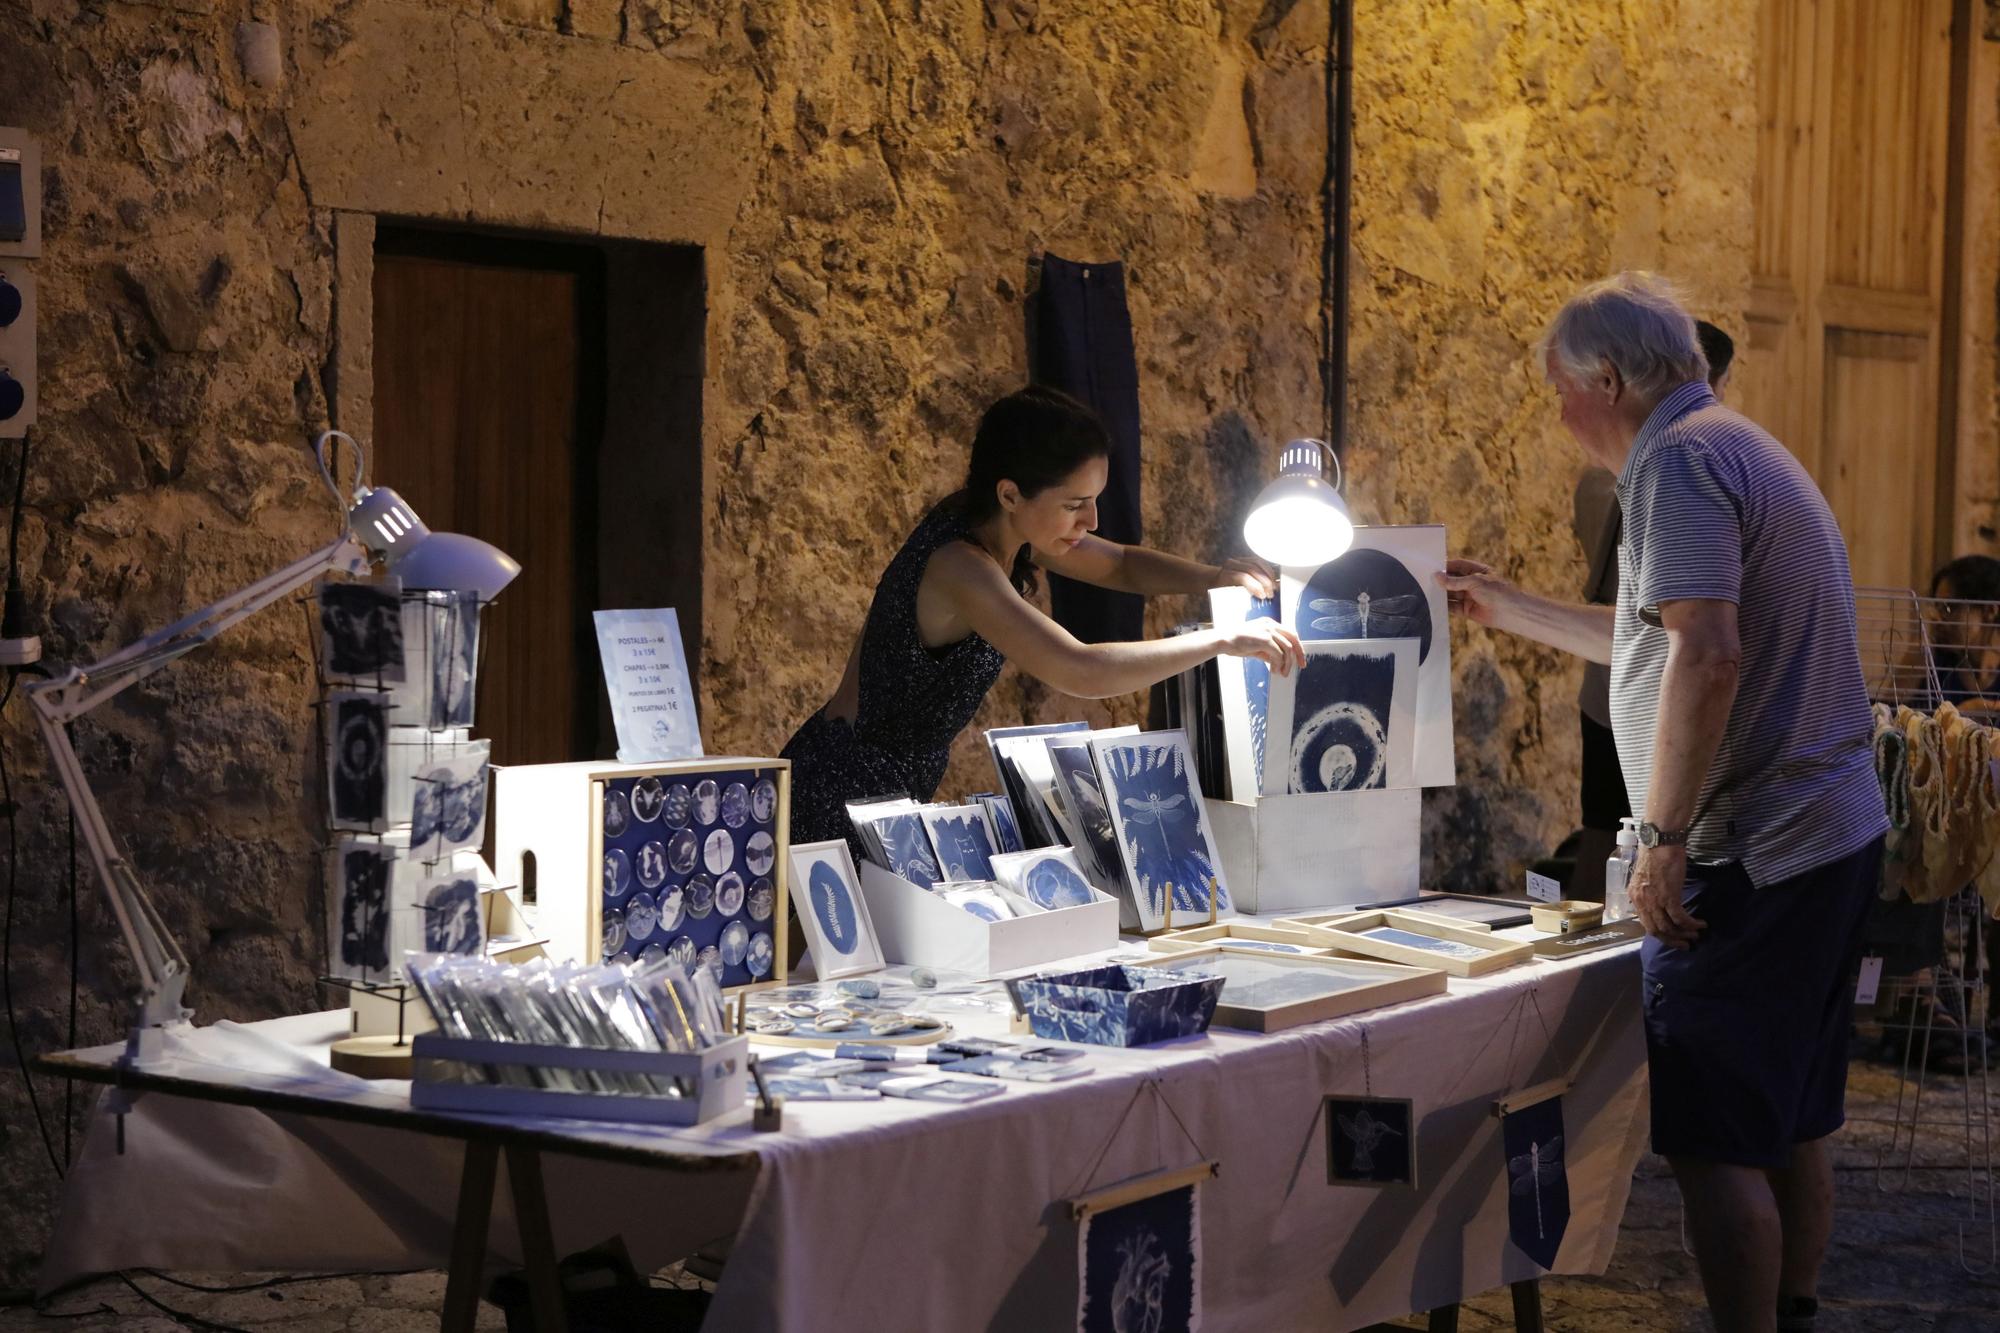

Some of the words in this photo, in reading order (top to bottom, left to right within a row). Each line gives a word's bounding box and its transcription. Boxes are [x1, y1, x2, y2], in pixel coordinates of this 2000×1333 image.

[618, 637, 648, 645] POSTALES
[637, 704, 667, 712] PEGATINAS
[667, 701, 678, 710] 1€
